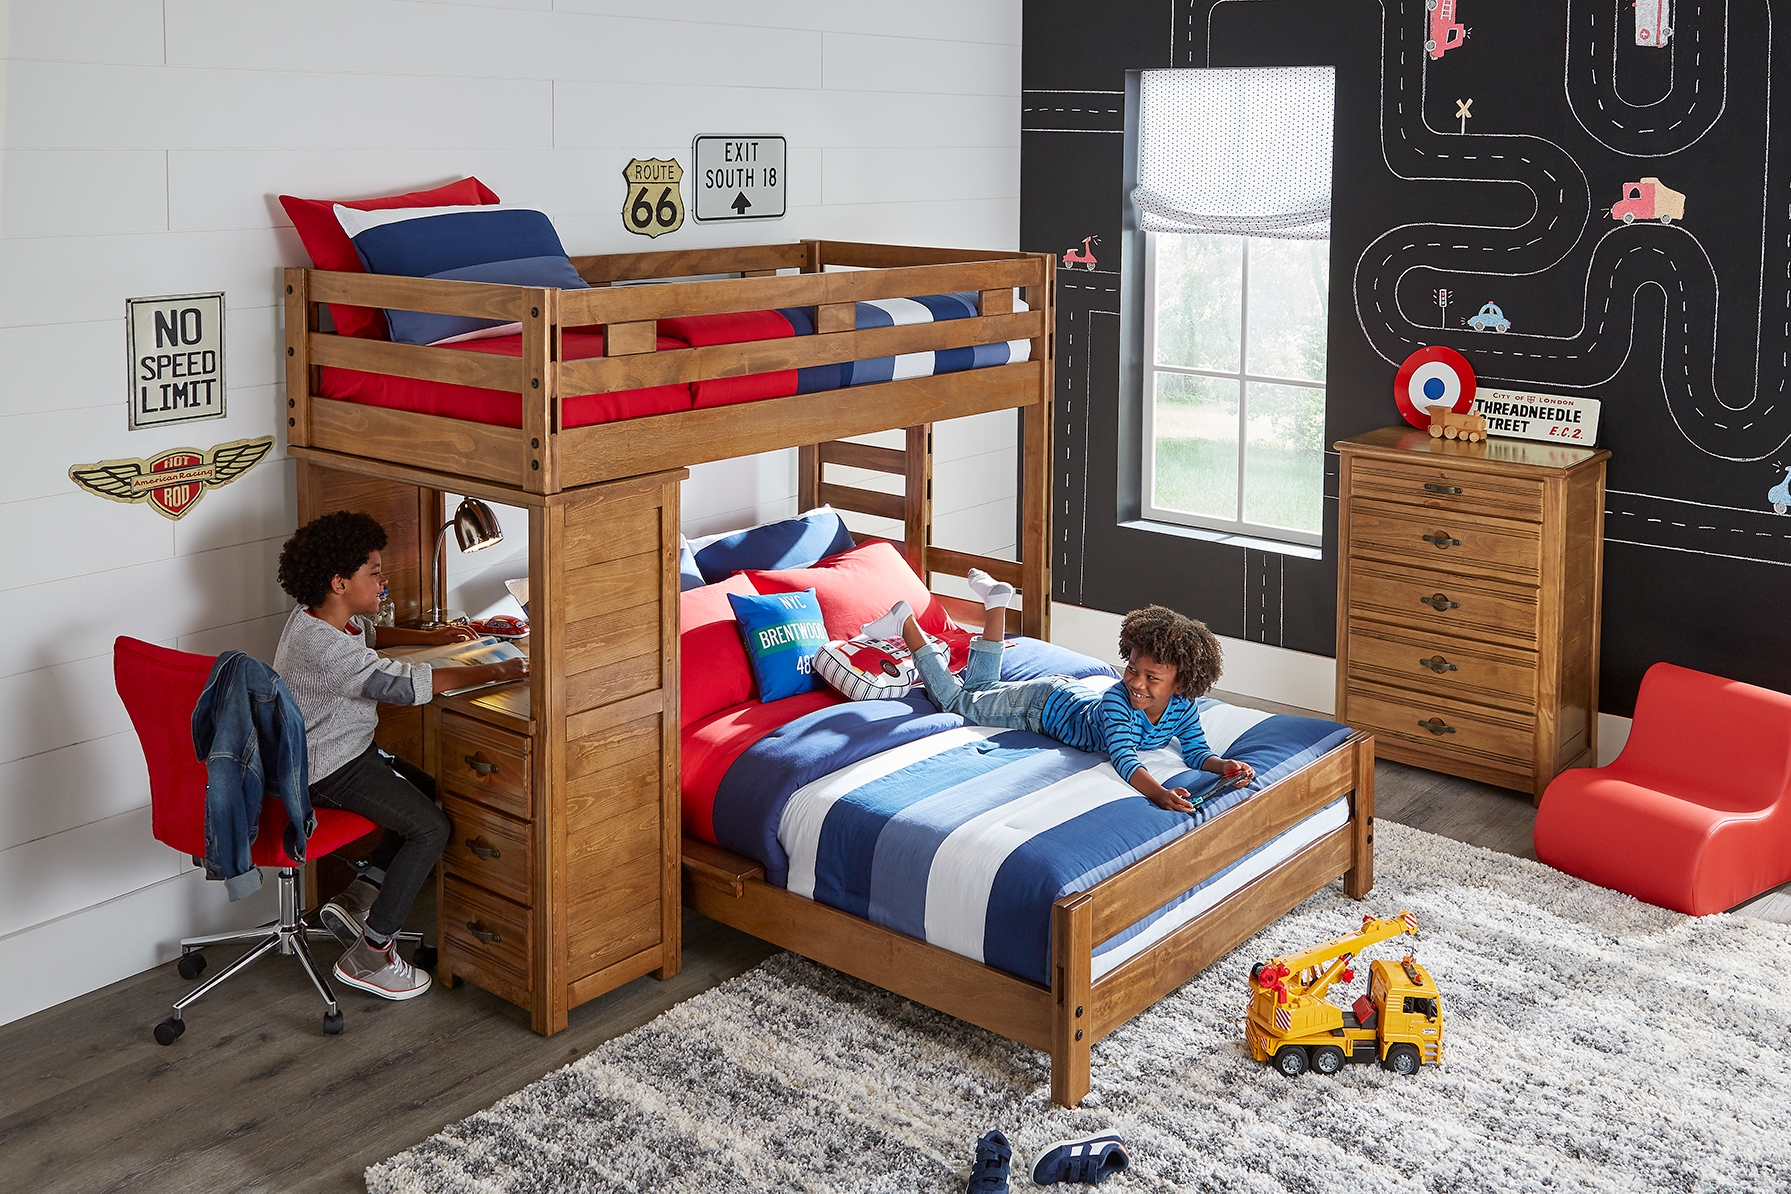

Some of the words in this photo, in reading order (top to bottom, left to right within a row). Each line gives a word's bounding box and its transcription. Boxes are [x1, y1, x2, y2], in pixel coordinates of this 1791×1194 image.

[725, 142, 759, 162] EXIT
[635, 164, 675, 180] ROUTE
[705, 168, 754, 189] SOUTH
[763, 167, 777, 187] 18
[631, 186, 677, 228] 66
[154, 308, 202, 349] NO
[141, 349, 217, 381] SPEED
[141, 378, 217, 414] LIMIT
[1539, 397, 1575, 406] LONDON
[1475, 398, 1582, 424] THREADNEEDLE
[1549, 426, 1583, 440] E.C.2.
[163, 456, 190, 469] HOT
[133, 474, 178, 487] American
[179, 469, 213, 479] Racing
[163, 484, 190, 507] ROD
[778, 595, 807, 610] NYC
[758, 621, 826, 650] BRENTWOOD
[796, 654, 816, 675] 48
